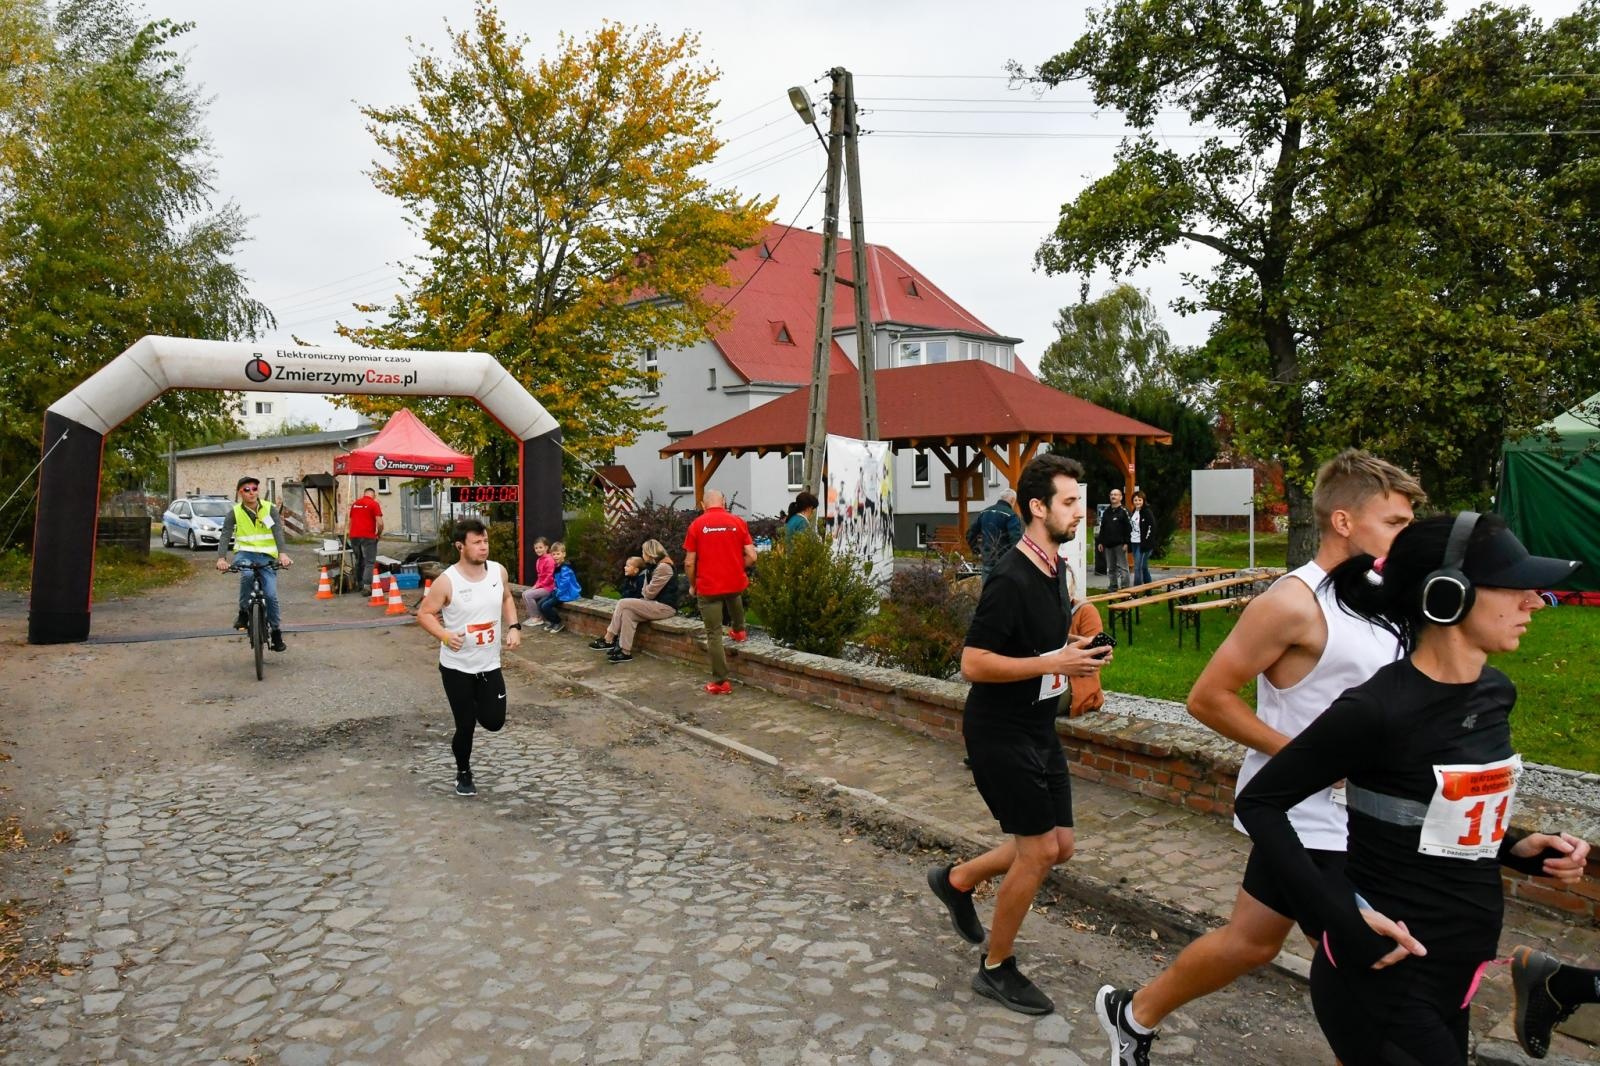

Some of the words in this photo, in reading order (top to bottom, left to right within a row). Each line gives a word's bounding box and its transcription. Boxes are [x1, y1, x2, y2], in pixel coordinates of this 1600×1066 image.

[276, 350, 346, 362] Elektroniczny
[348, 354, 382, 363] pomiar
[275, 365, 418, 387] ZmierzymyCzas.pl
[475, 629, 495, 645] 13
[1457, 795, 1509, 846] 11
